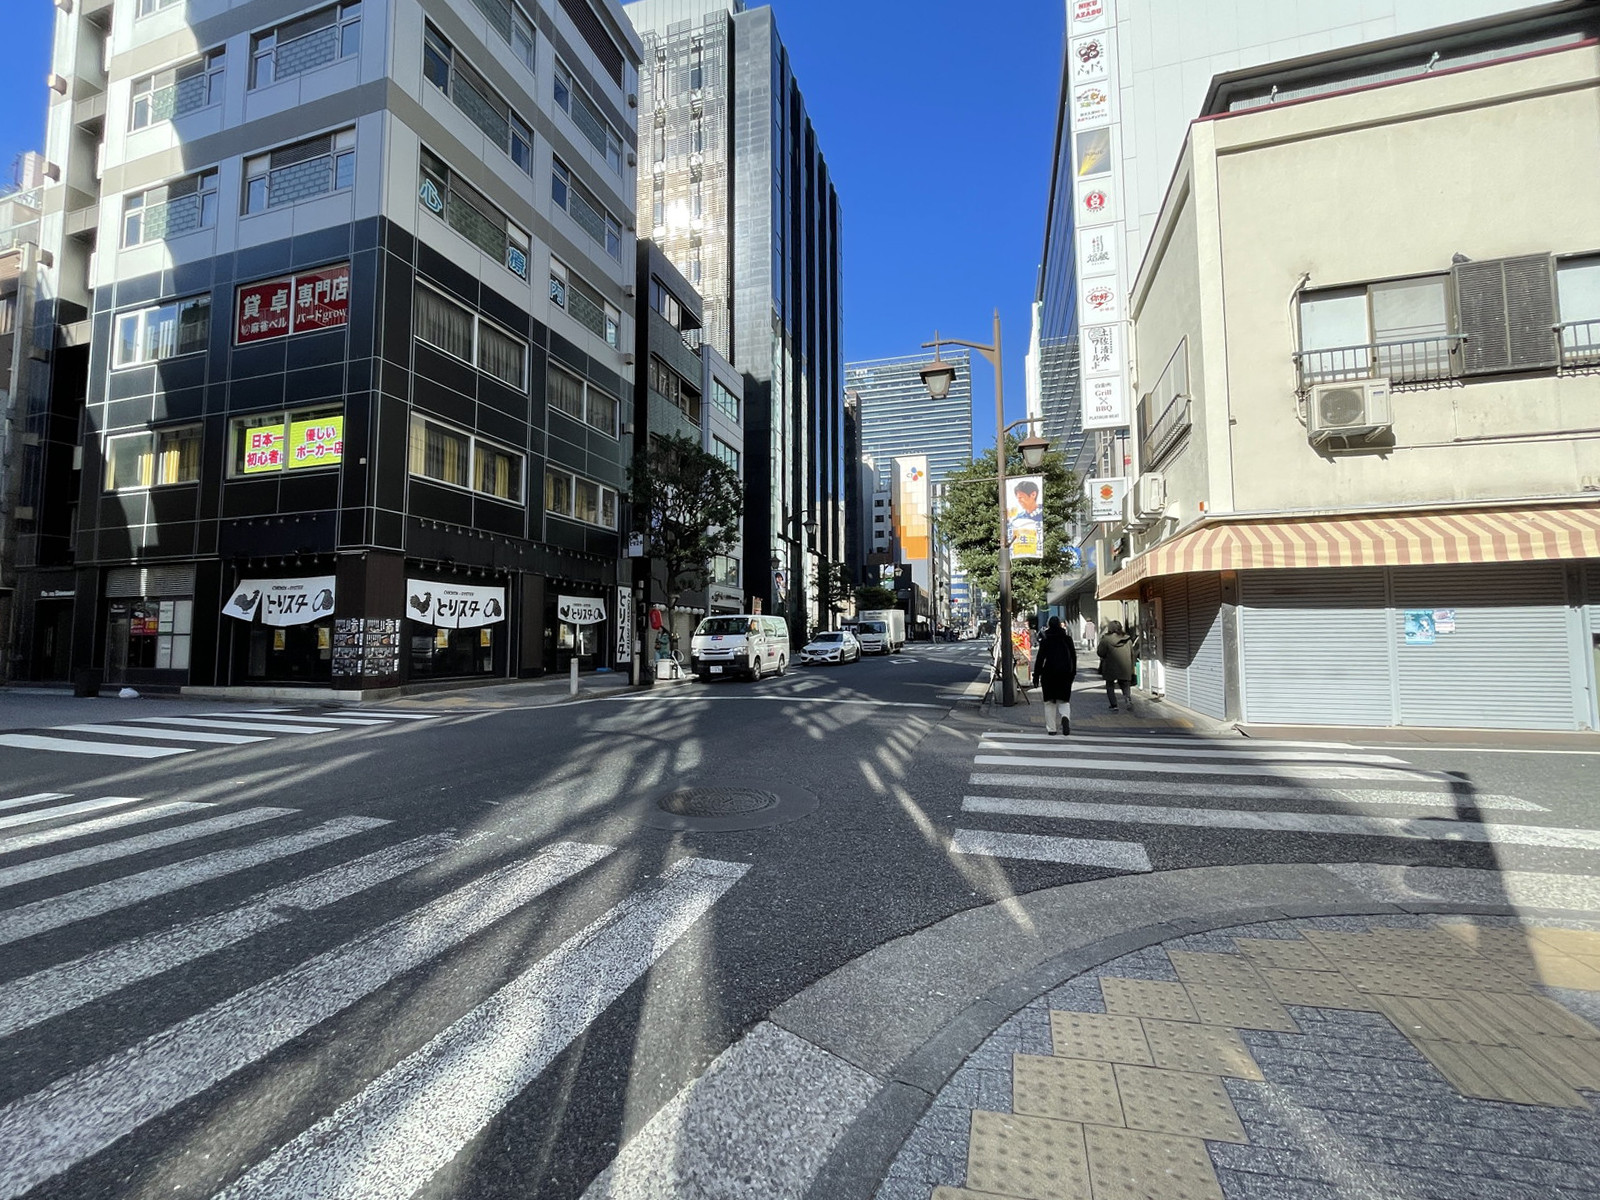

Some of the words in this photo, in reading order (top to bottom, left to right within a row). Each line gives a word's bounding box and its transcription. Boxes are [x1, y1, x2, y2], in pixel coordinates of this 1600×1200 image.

[252, 433, 284, 448] 日本一
[305, 427, 336, 441] 優しい
[296, 441, 344, 459] ポーカー店
[1020, 535, 1027, 544] 生
[437, 597, 480, 617] とりスタ
[571, 608, 593, 620] とりスタ
[618, 590, 626, 660] とりスタ
